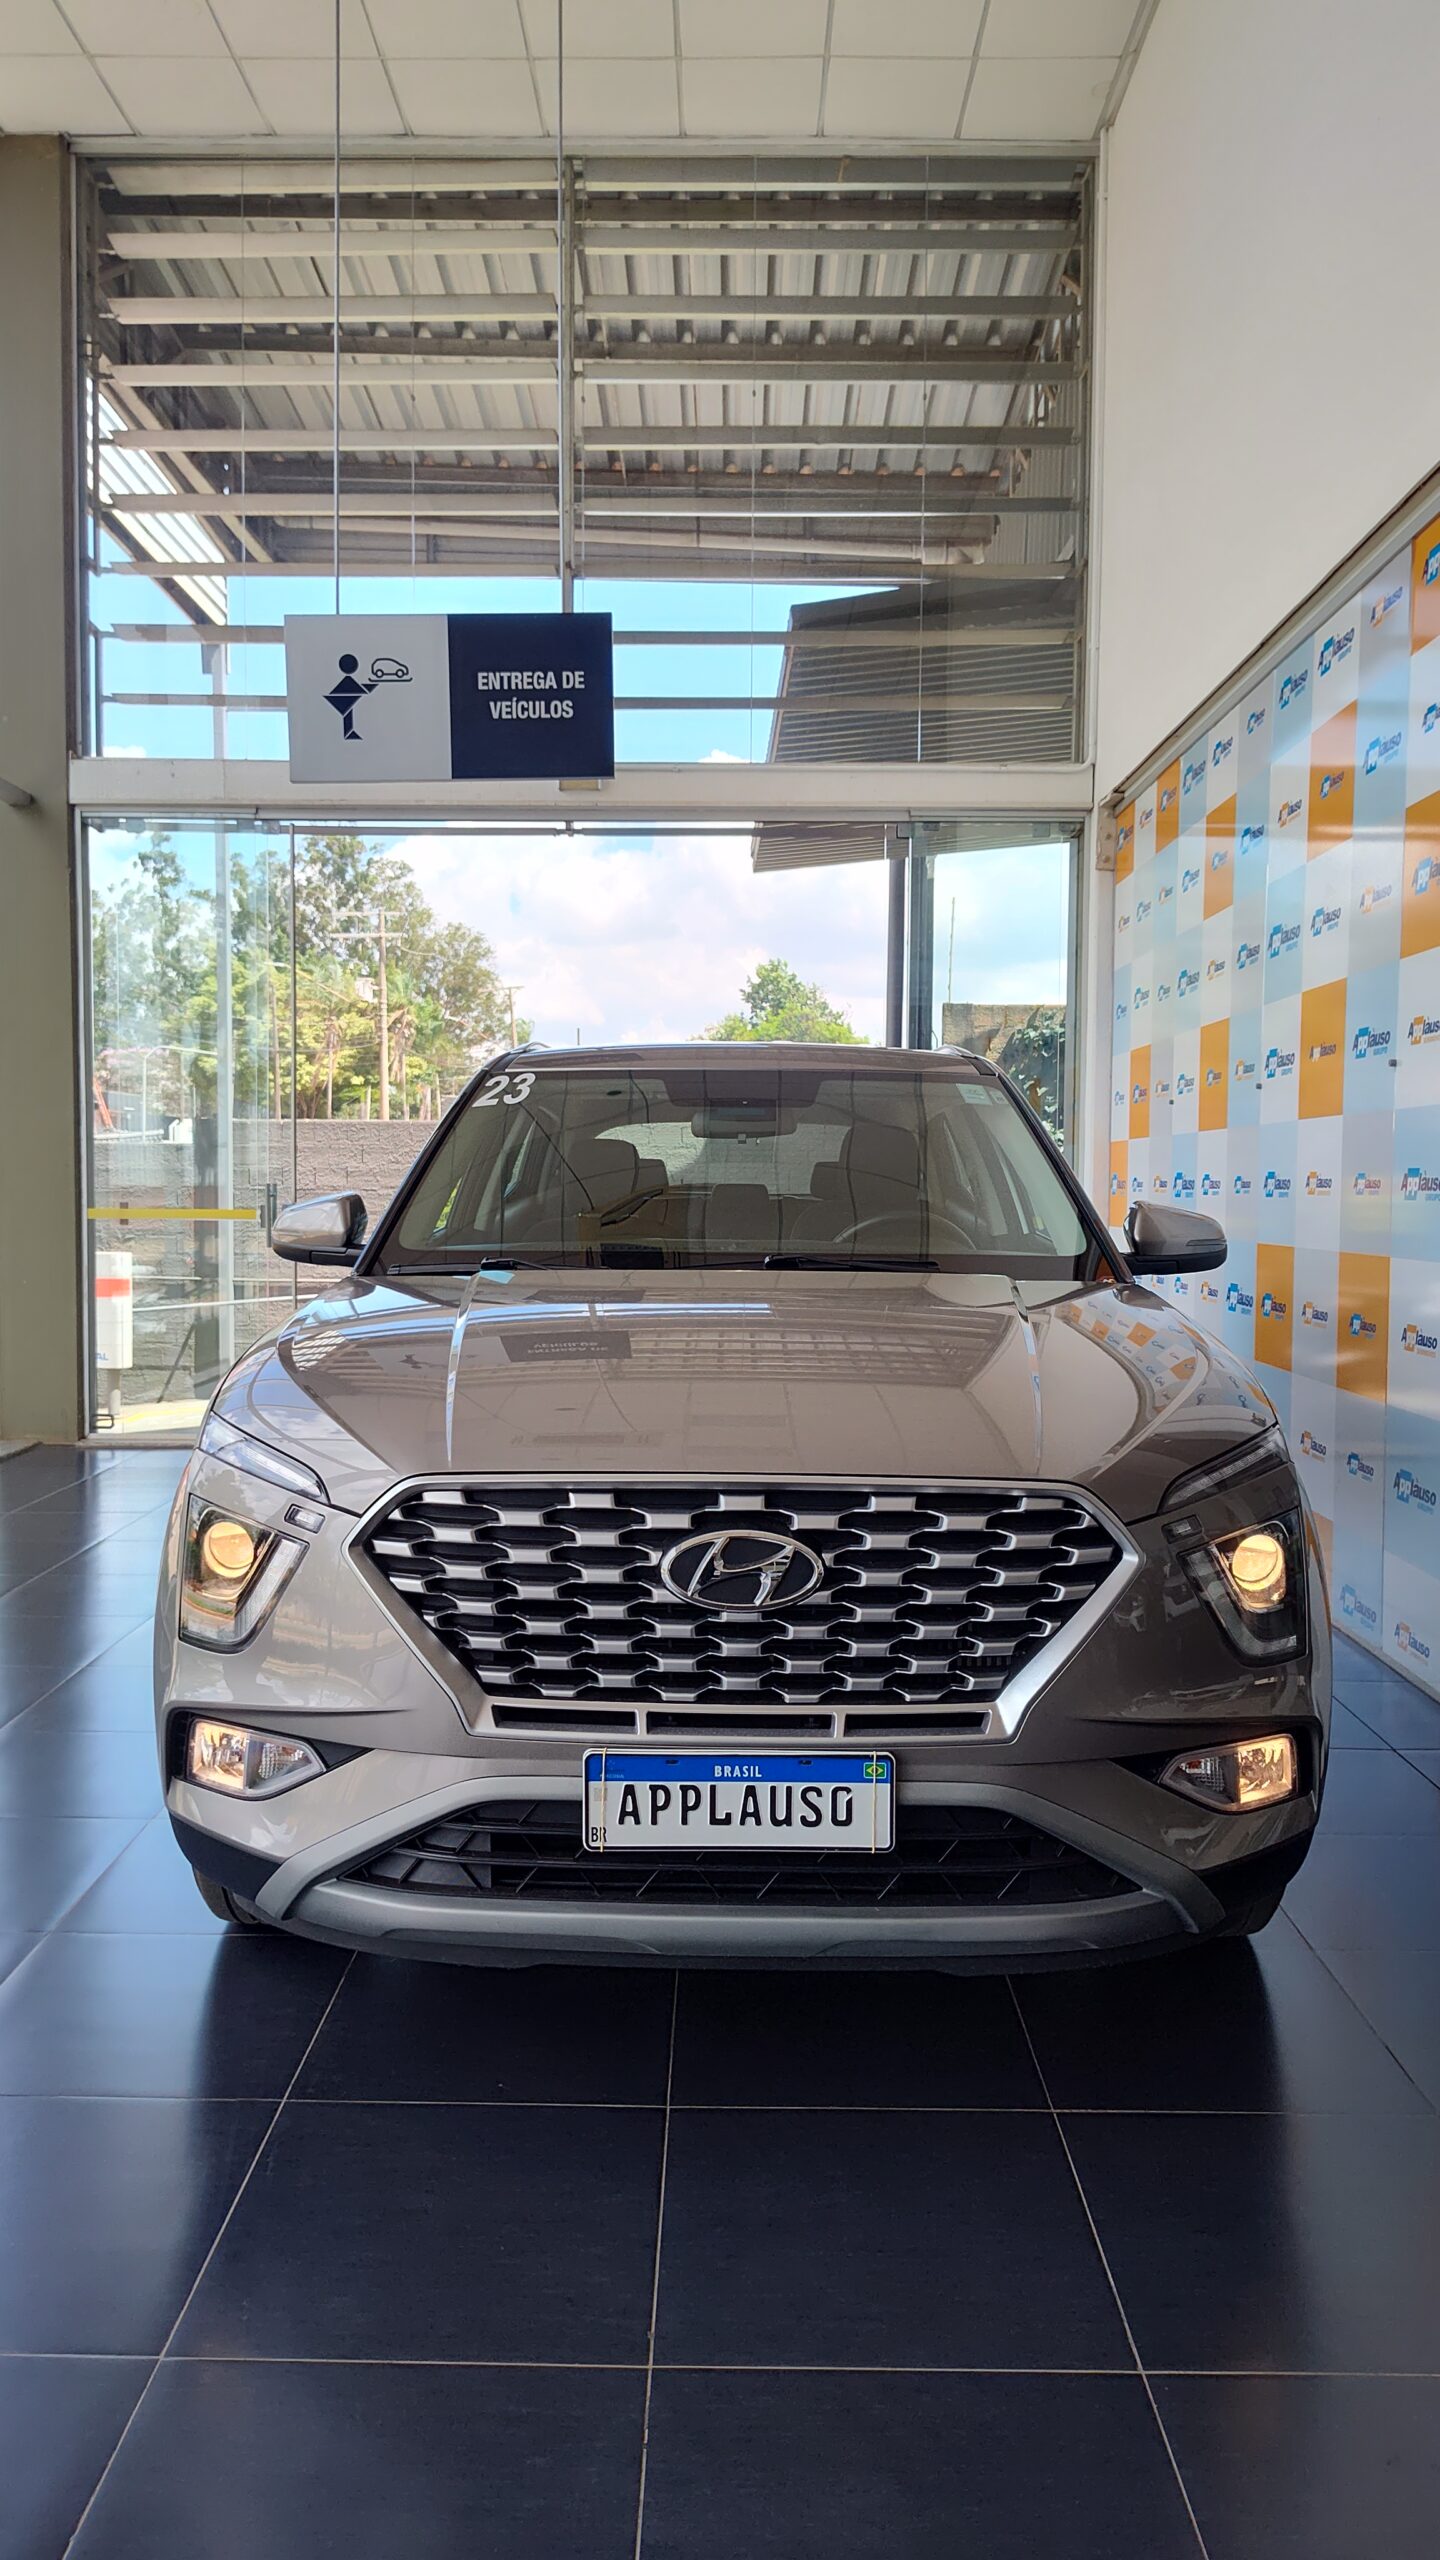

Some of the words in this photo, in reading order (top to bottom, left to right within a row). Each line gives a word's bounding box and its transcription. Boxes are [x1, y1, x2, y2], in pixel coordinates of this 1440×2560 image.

[477, 671, 557, 690] ENTREGA
[562, 671, 585, 689] DE
[490, 697, 574, 719] VEÍCULOS
[473, 1072, 536, 1106] 23
[714, 1765, 762, 1778] BRASIL
[617, 1784, 854, 1828] APPLAUSO
[591, 1827, 607, 1843] BR
